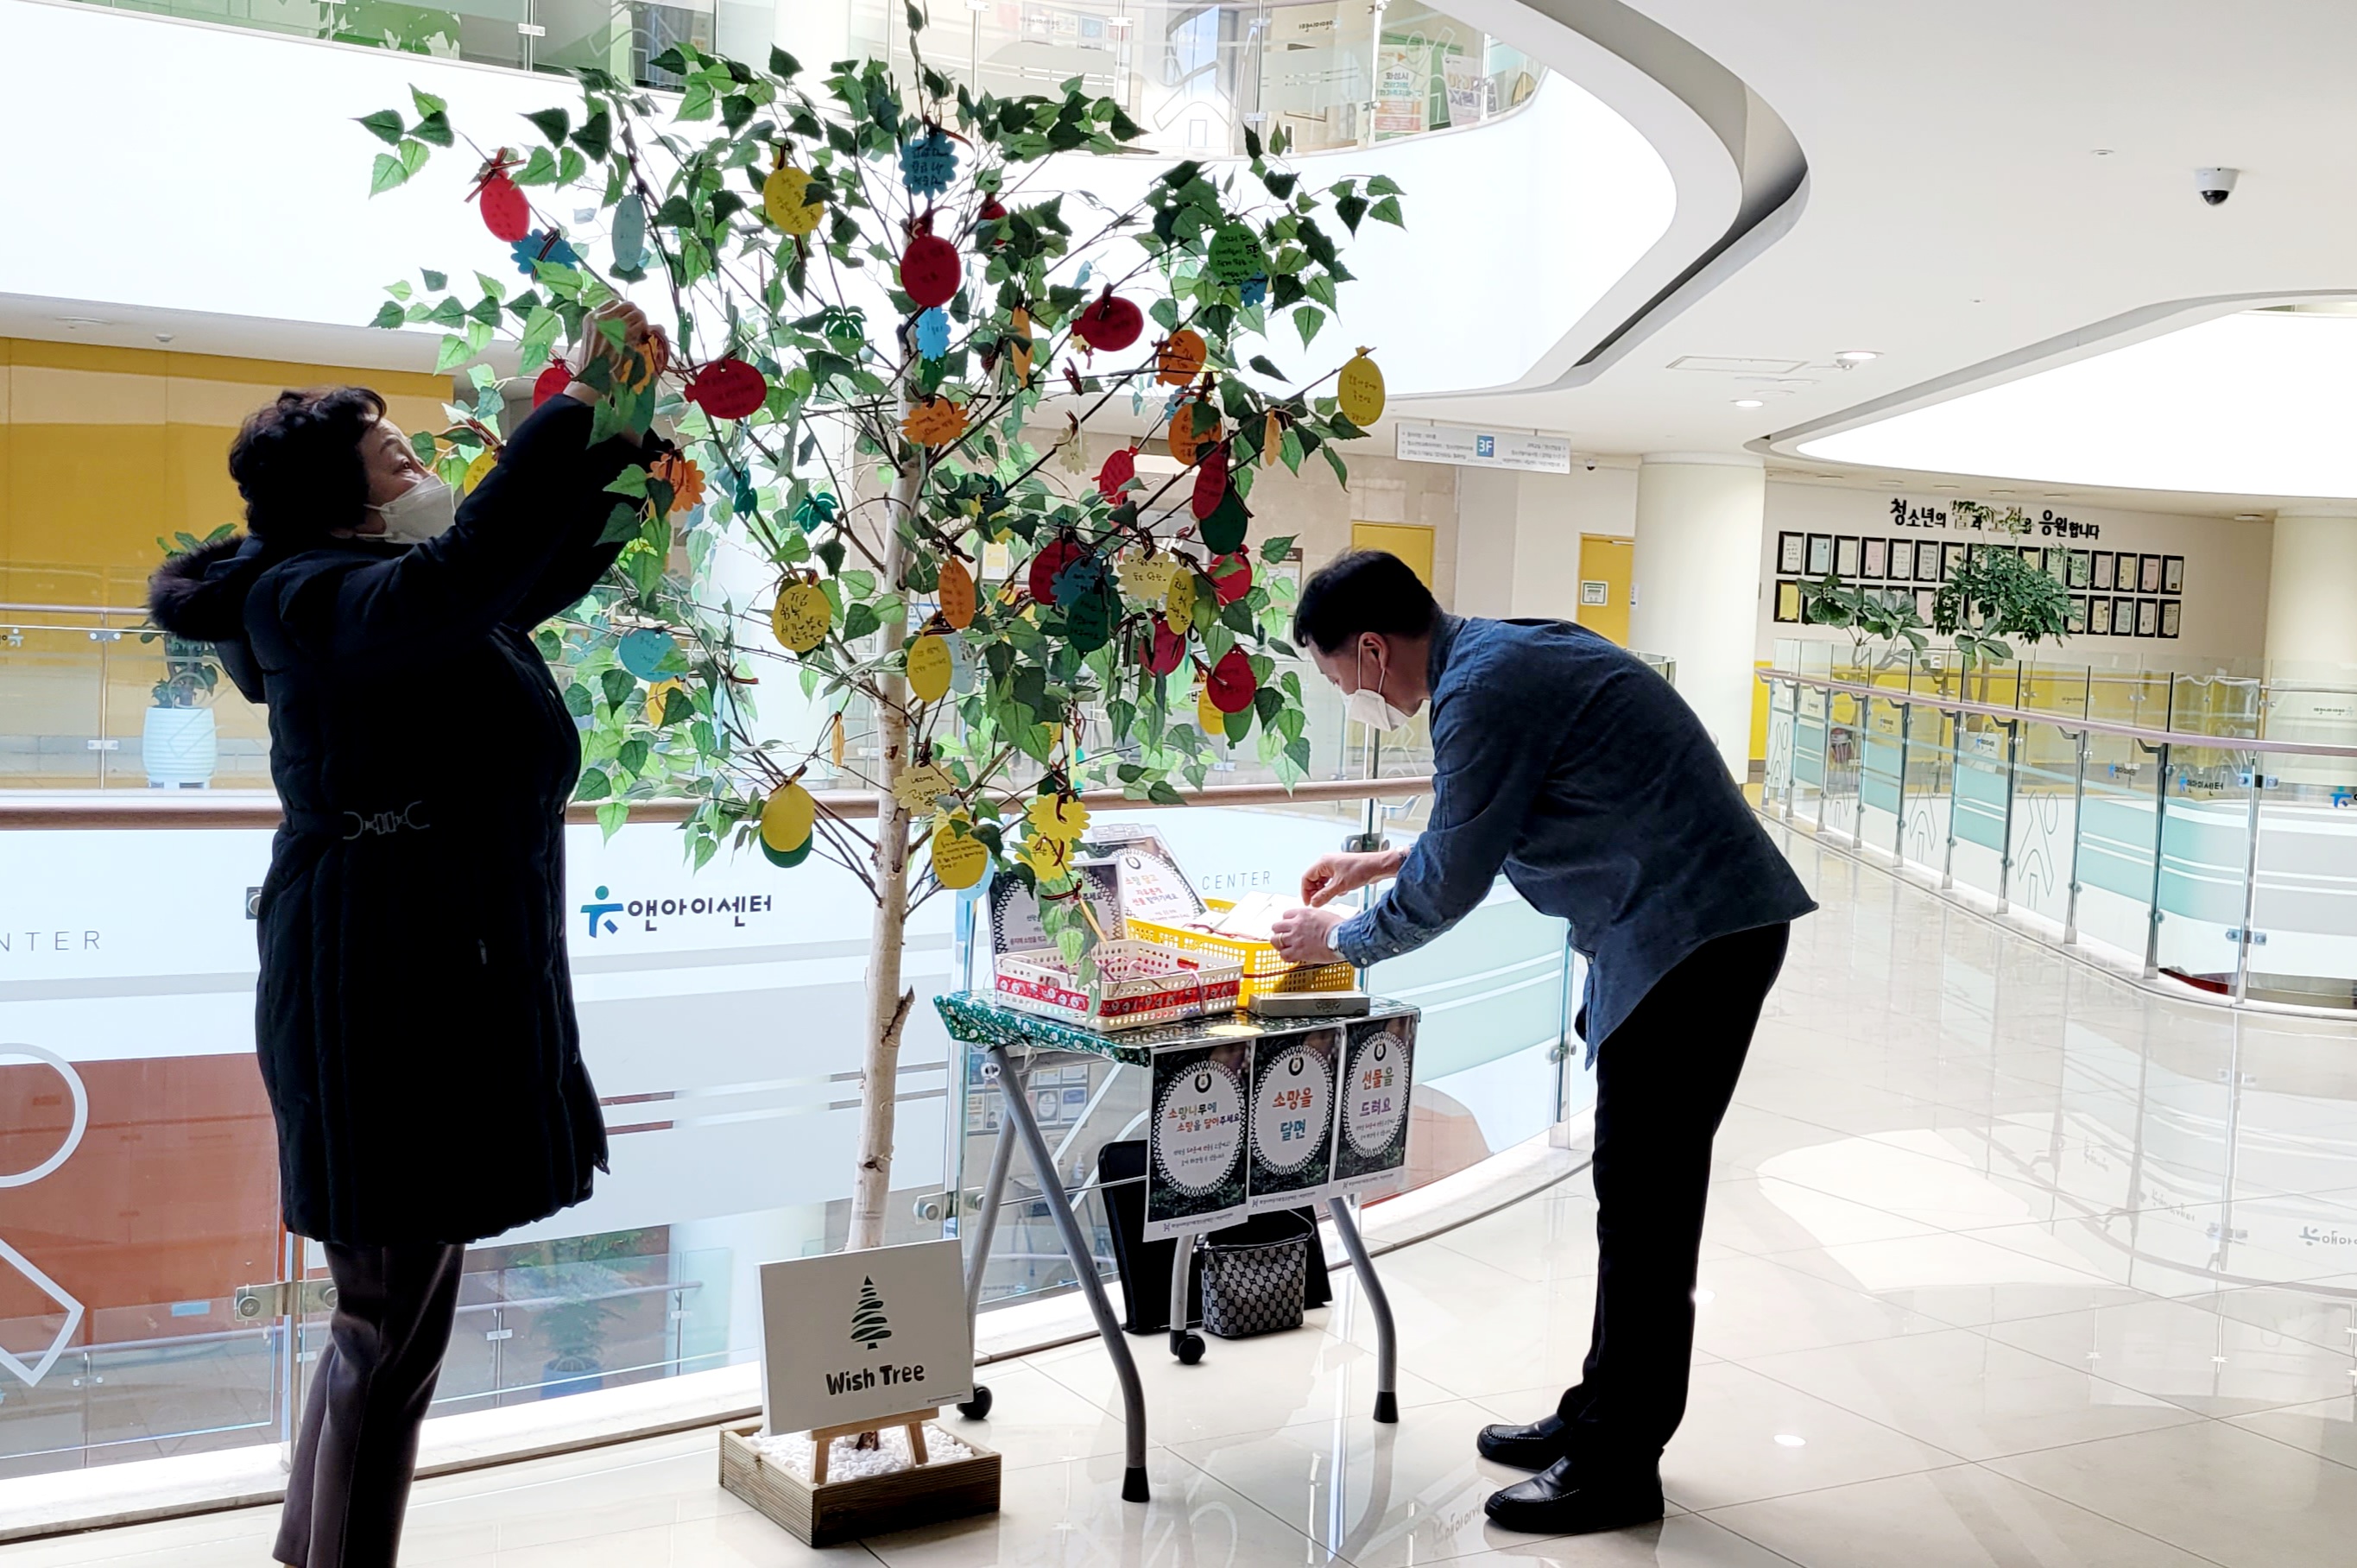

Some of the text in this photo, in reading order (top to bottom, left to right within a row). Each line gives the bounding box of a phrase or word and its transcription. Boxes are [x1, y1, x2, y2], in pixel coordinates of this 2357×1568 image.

[1385, 72, 1409, 80] 화성시
[1478, 439, 1493, 453] 3F
[1890, 498, 1947, 528] 청소년의
[2038, 509, 2101, 541] 응원합니다
[1201, 870, 1272, 890] CENTER
[1362, 1066, 1394, 1091] 선물을
[1272, 1087, 1313, 1110] 소망을
[1359, 1097, 1392, 1116] 드려요
[1167, 1101, 1218, 1120] 소망나무에
[1176, 1112, 1242, 1132] 소망을 달아주세요
[1280, 1119, 1306, 1141] 달면
[825, 1364, 925, 1395] Wish Tree
